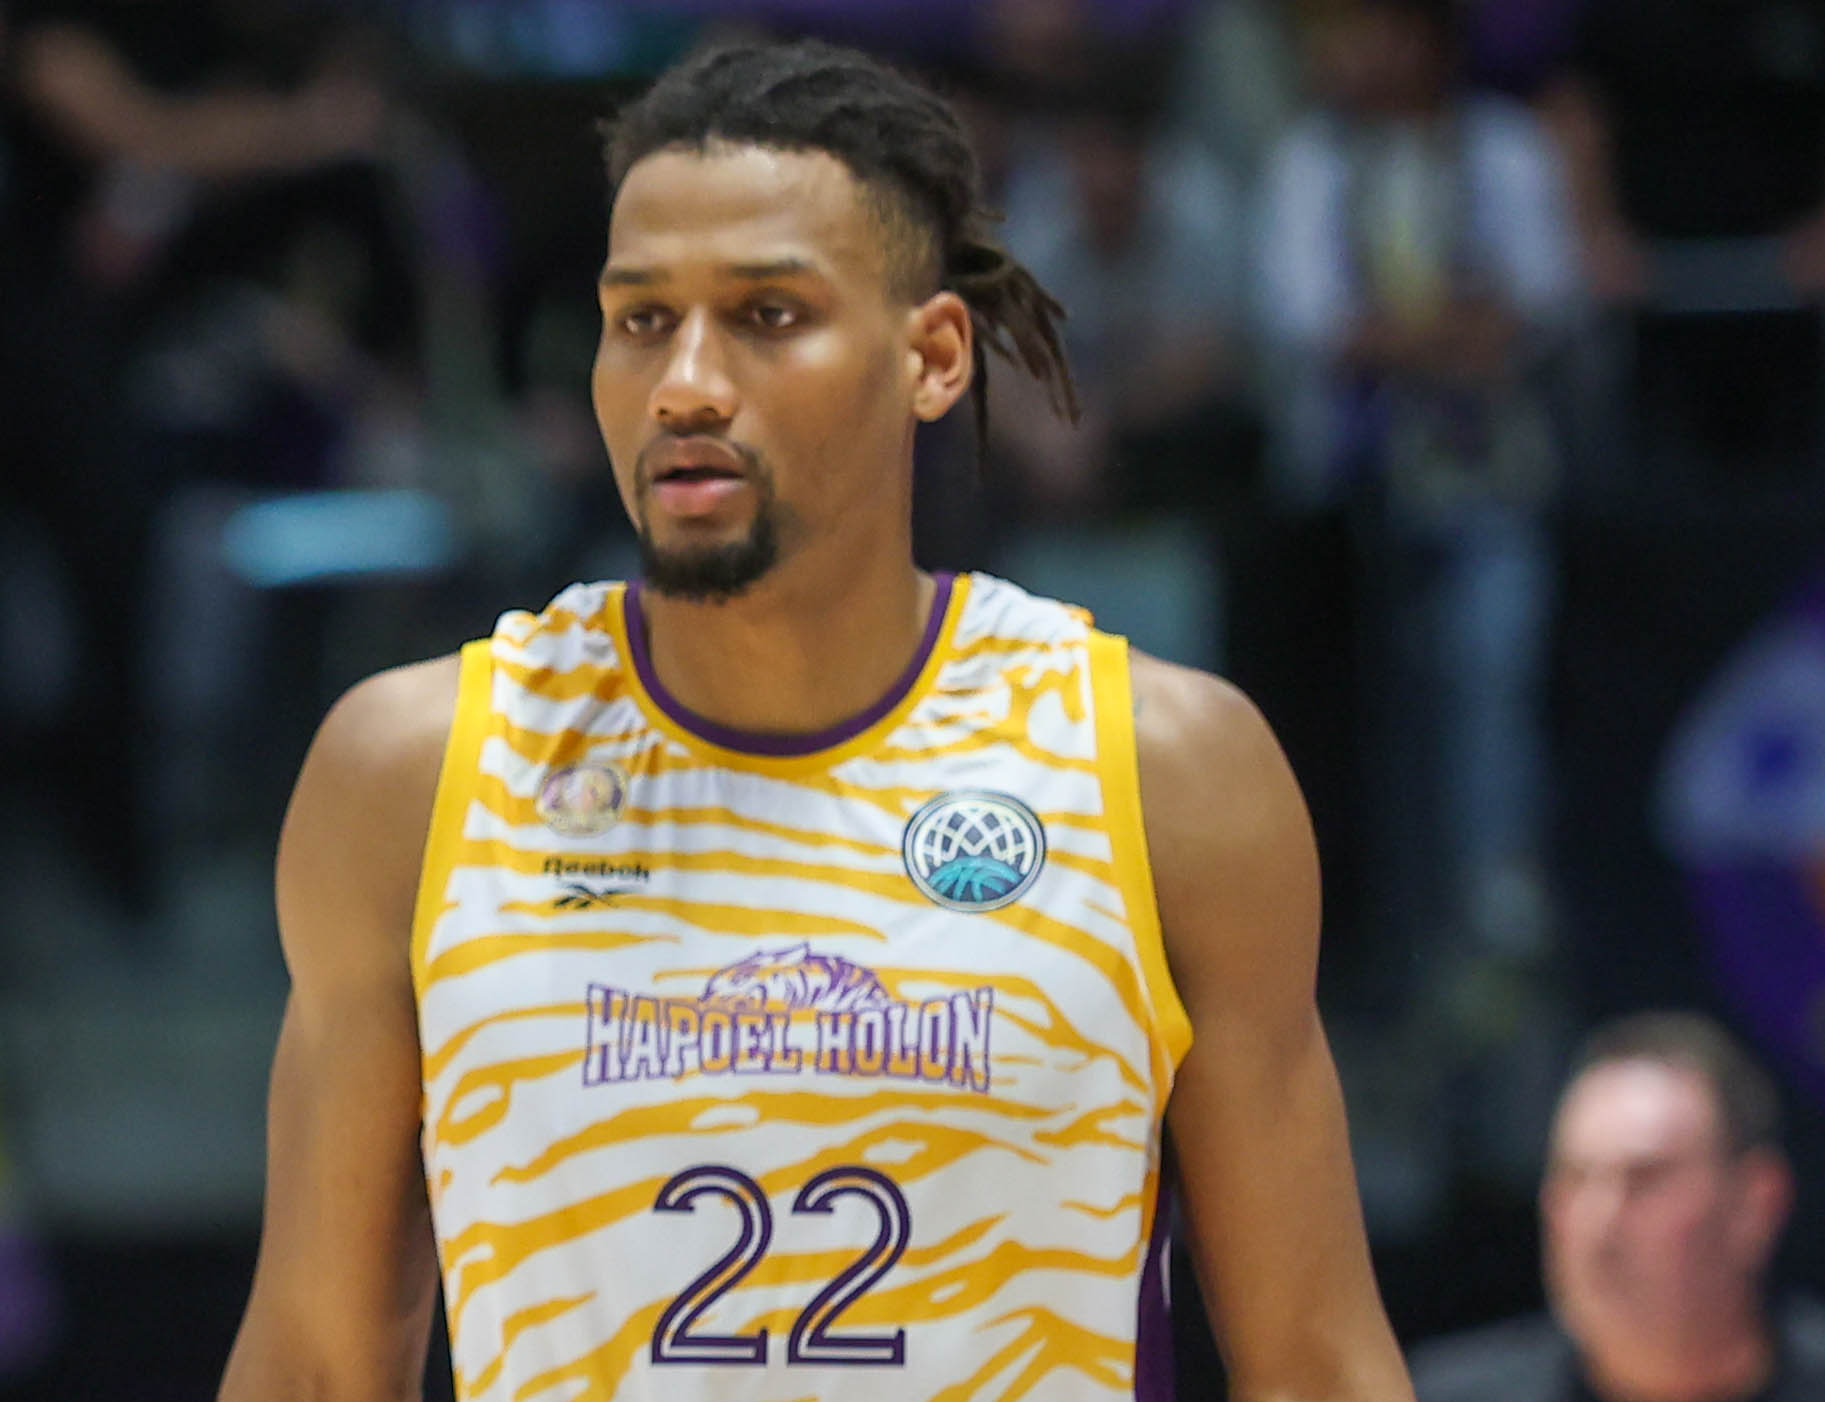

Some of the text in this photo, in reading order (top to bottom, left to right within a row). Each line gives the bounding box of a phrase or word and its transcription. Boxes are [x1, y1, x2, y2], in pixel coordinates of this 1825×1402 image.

[582, 982, 994, 1095] HAPOEL HOLON
[651, 1163, 911, 1368] 22
